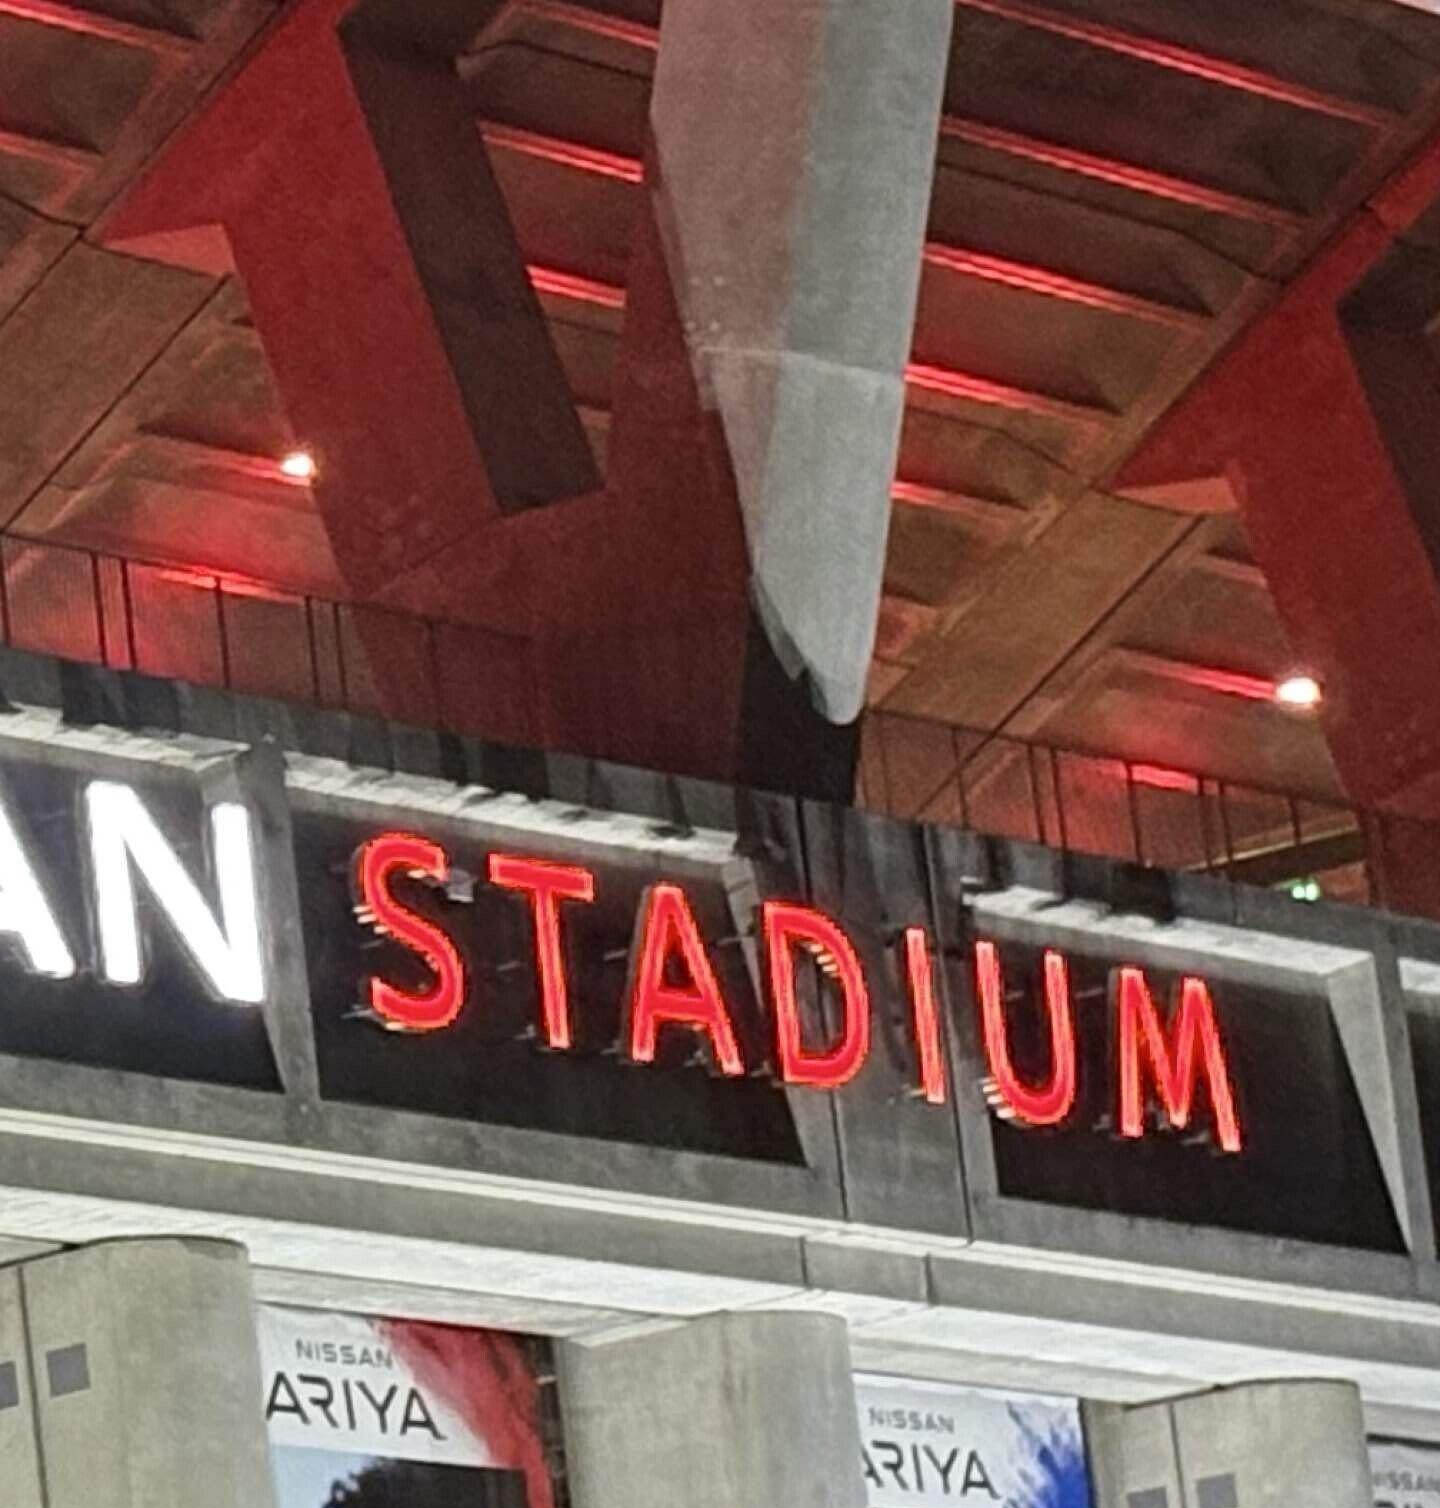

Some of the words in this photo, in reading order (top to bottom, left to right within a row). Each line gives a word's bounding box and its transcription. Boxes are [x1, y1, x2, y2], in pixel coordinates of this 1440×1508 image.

[359, 832, 1242, 1152] STADIUM
[295, 1338, 393, 1368] NISSAN
[266, 1371, 447, 1440] ARIYA
[868, 1407, 954, 1434] NISSAN
